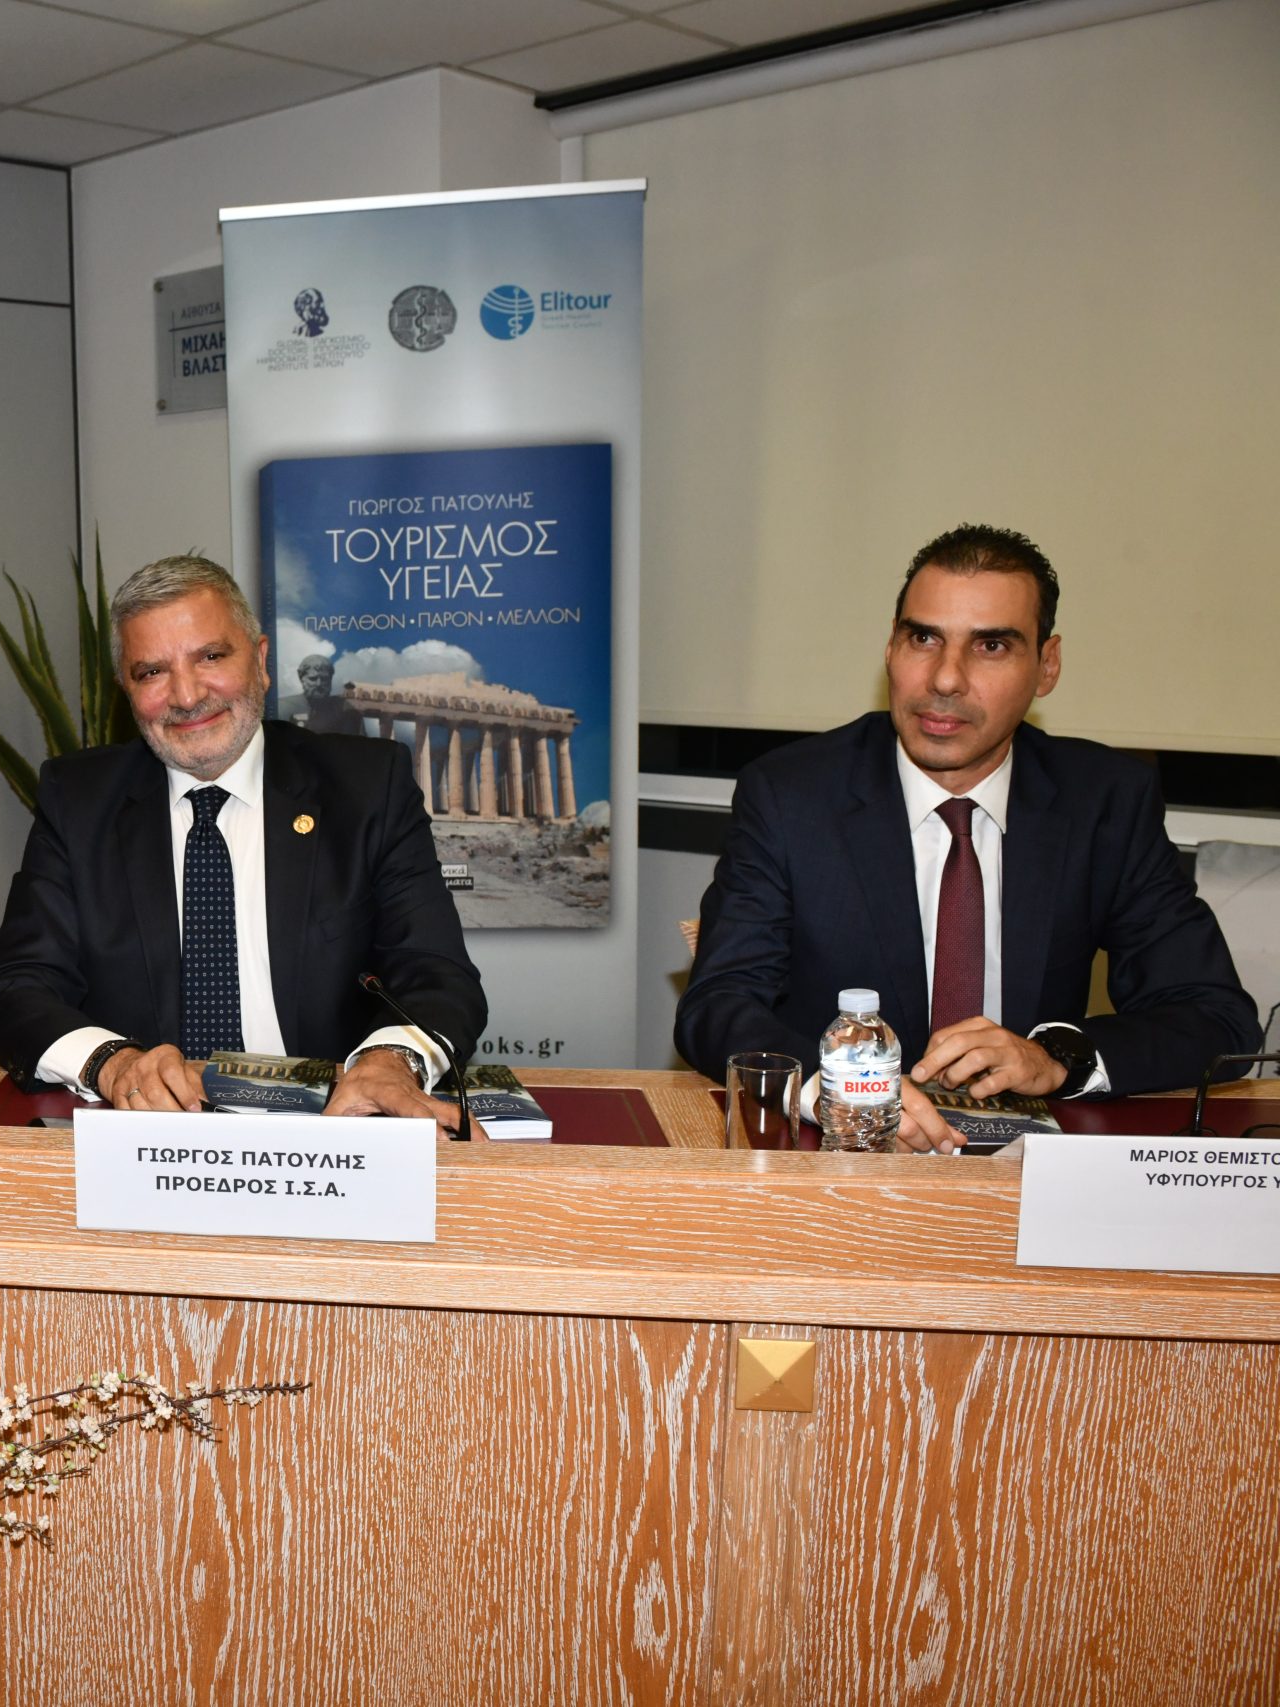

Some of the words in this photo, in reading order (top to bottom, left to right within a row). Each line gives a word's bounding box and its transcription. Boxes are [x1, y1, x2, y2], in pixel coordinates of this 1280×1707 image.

[541, 291, 612, 312] Elitour
[348, 497, 424, 516] ΓΙΩΡΓΟΣ
[431, 492, 534, 513] ΠΑΤΟΥΛΗΣ
[325, 520, 558, 563] ΤΟΥΡΙΣΜΟΣ
[379, 563, 503, 601] ΥΓΕΙΑΣ
[305, 614, 405, 632] ΠΑΡΕΛΘΟΝ
[418, 610, 483, 628] ΠΑΡΟΝ
[496, 607, 580, 626] ΜΕΛΛΟΝ
[844, 1081, 889, 1092] ΒΙΚΟΣ
[137, 1147, 233, 1165] ΓΙΩΡΓΟΣ
[242, 1151, 366, 1170] ΠΑΤΟΥΛΗΣ
[1130, 1149, 1199, 1163] ΜΑΡΙΟΣ
[1204, 1151, 1280, 1165] ΘΕΜΙΣΤΟ
[156, 1175, 277, 1194] ΠΡΟΕΔΡΟΣ
[285, 1180, 346, 1197] Ι.Σ.Α.
[1145, 1172, 1267, 1188] ΥΦΥΠΟΥΡΓΟΣ
